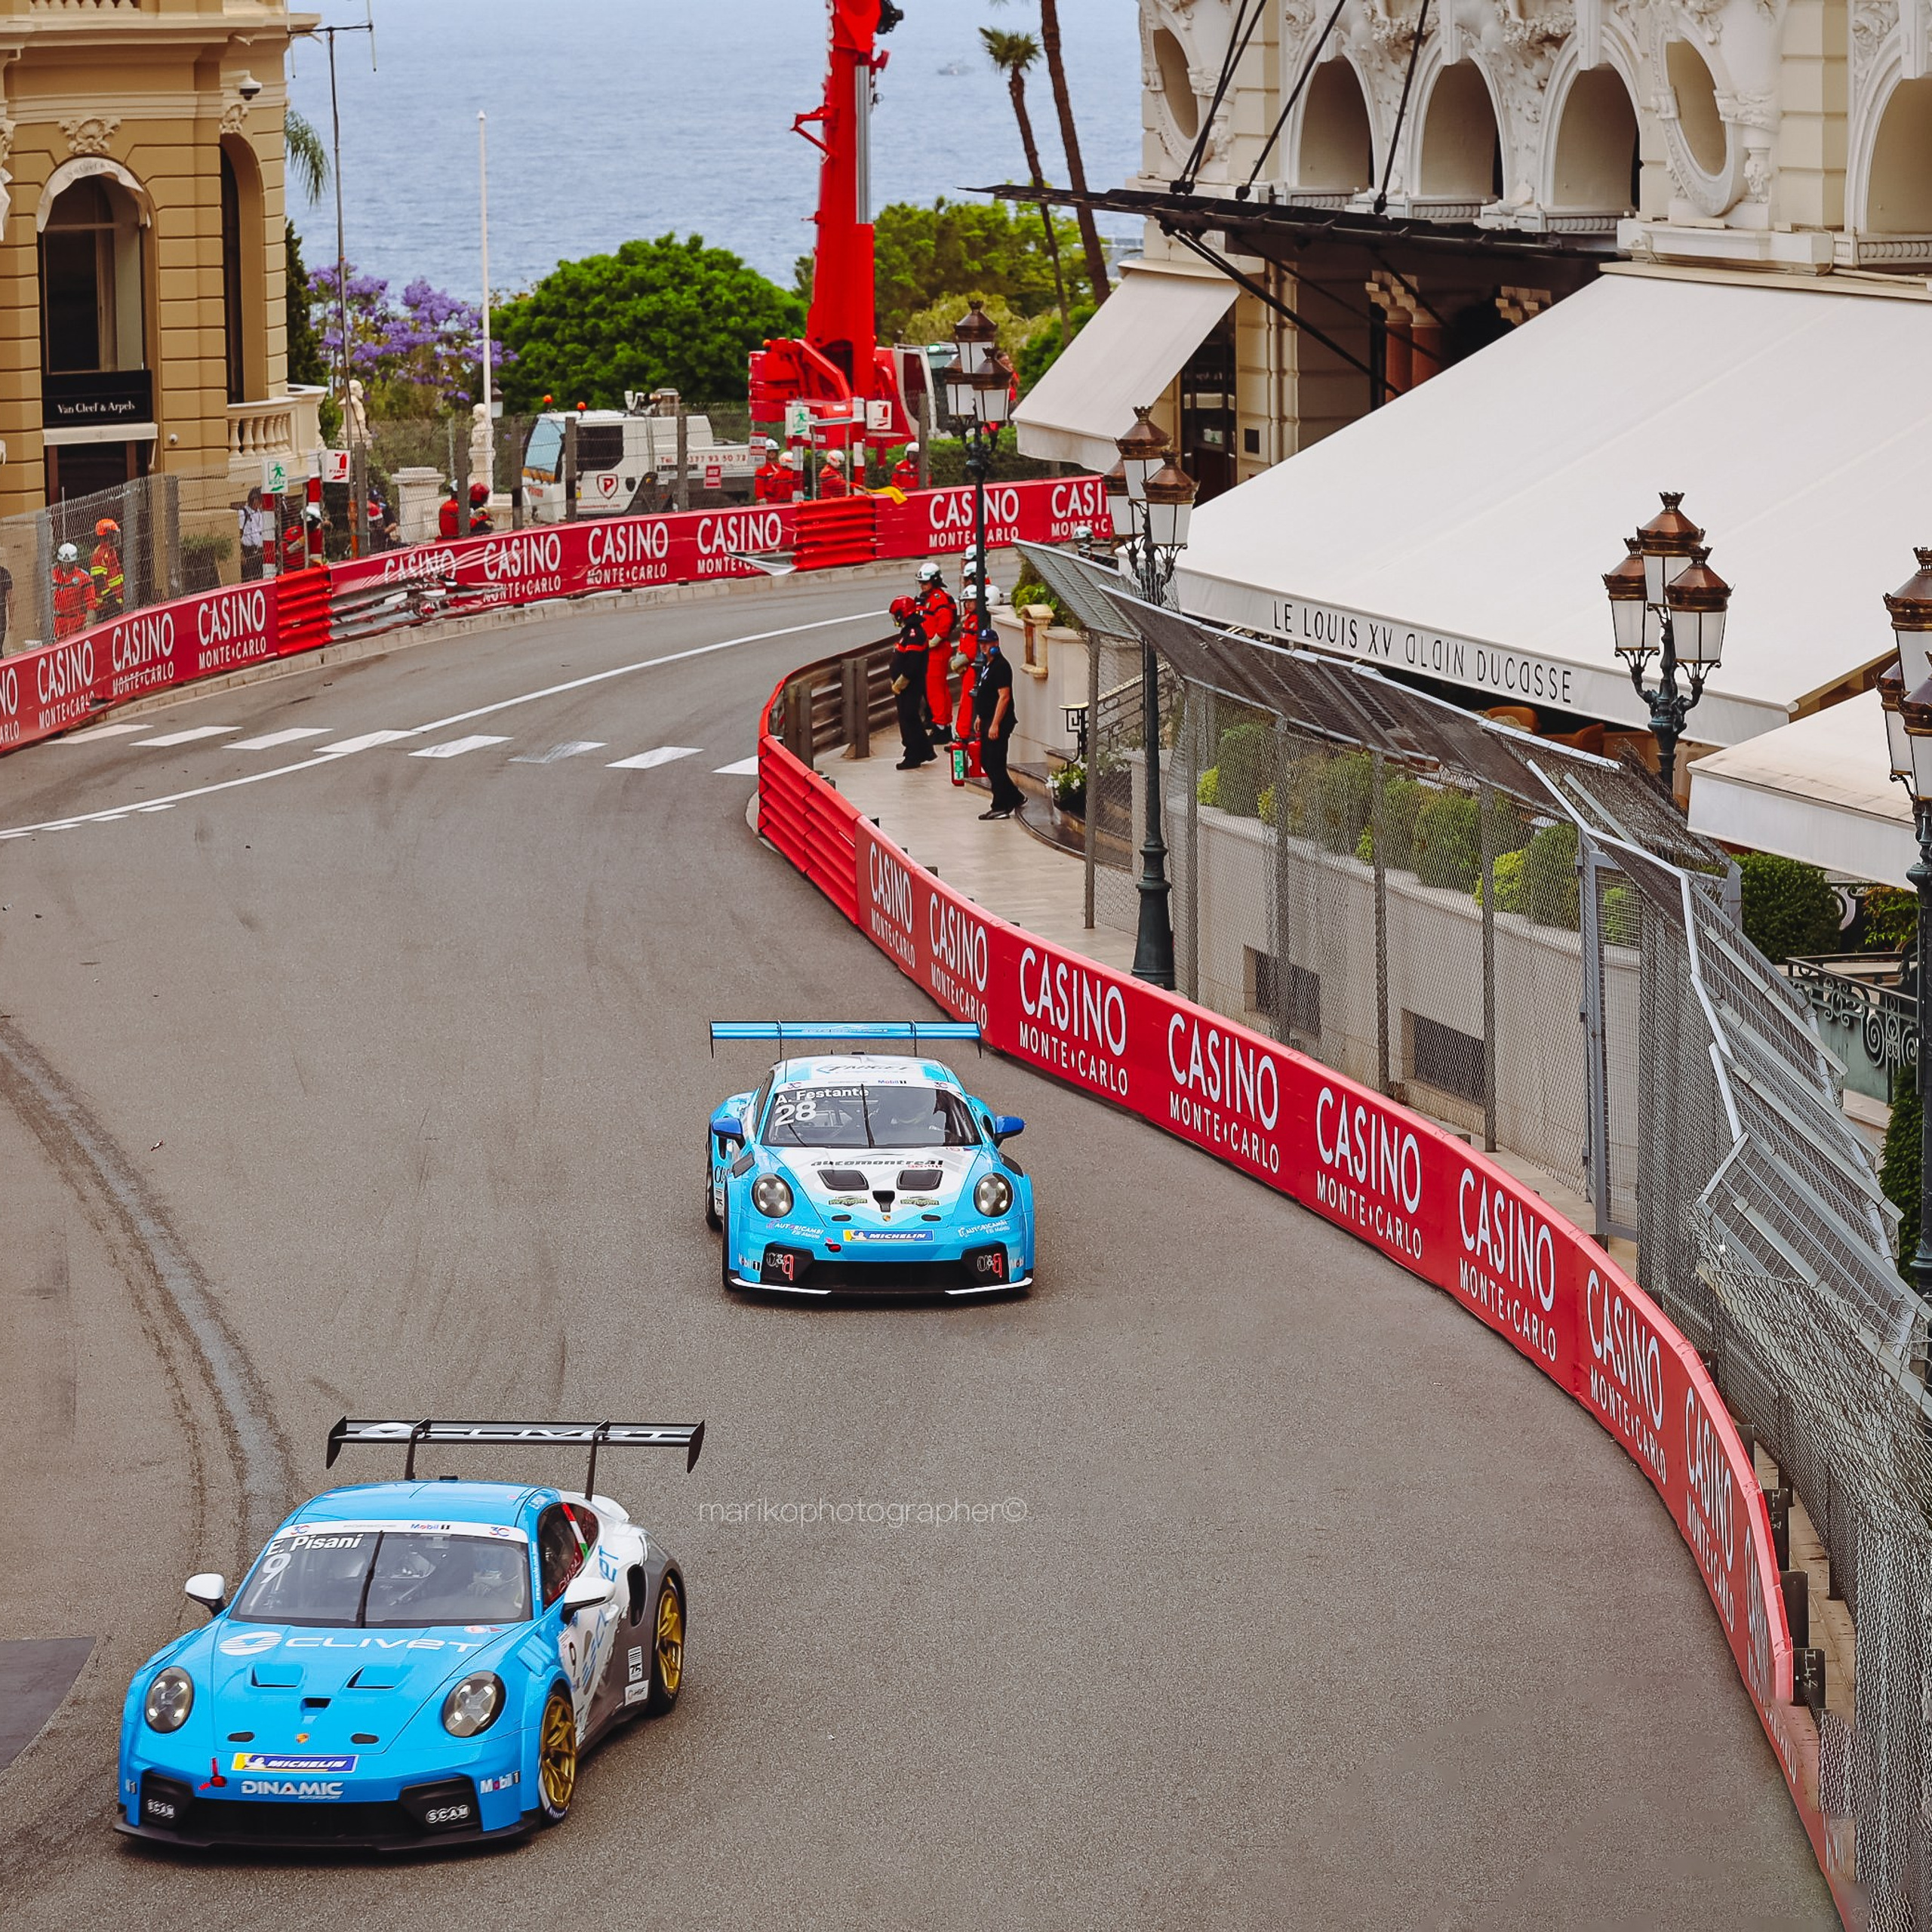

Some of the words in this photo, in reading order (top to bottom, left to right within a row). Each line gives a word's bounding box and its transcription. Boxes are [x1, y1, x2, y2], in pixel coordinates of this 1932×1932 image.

[57, 404, 74, 414] Van
[75, 402, 98, 413] Cleef
[108, 400, 135, 414] Arpels
[929, 488, 1020, 530] CASNO
[484, 533, 561, 580] CASINO
[588, 521, 669, 566] CASINO
[697, 512, 782, 555] CASINO
[198, 589, 266, 646] CASINO
[1273, 601, 1293, 632] LE
[1303, 608, 1358, 649] LOUIS
[1368, 623, 1392, 658] XV
[112, 612, 175, 672] CASINO
[38, 639, 94, 705] CASINO
[869, 841, 912, 934] CASINO
[929, 892, 989, 992] CASINO
[1019, 947, 1128, 1057] CASINO
[1168, 1013, 1279, 1131] CASINO
[774, 1100, 817, 1128] 28
[775, 1094, 792, 1106] A.
[796, 1087, 870, 1101] Festante
[1315, 1087, 1422, 1214] CASINO
[1459, 1168, 1556, 1312] CASINO
[1587, 1269, 1663, 1432] CASINO
[1685, 1386, 1734, 1573] CASINO
[261, 1552, 292, 1584] 9
[266, 1540, 285, 1556] E.
[290, 1534, 365, 1552] Pisani
[285, 1637, 484, 1653] CLIVET
[266, 1759, 348, 1768] MICHELIN
[480, 1774, 513, 1795] Mobil
[241, 1780, 344, 1795] DINAMIC
[426, 1804, 469, 1823] SCAM
